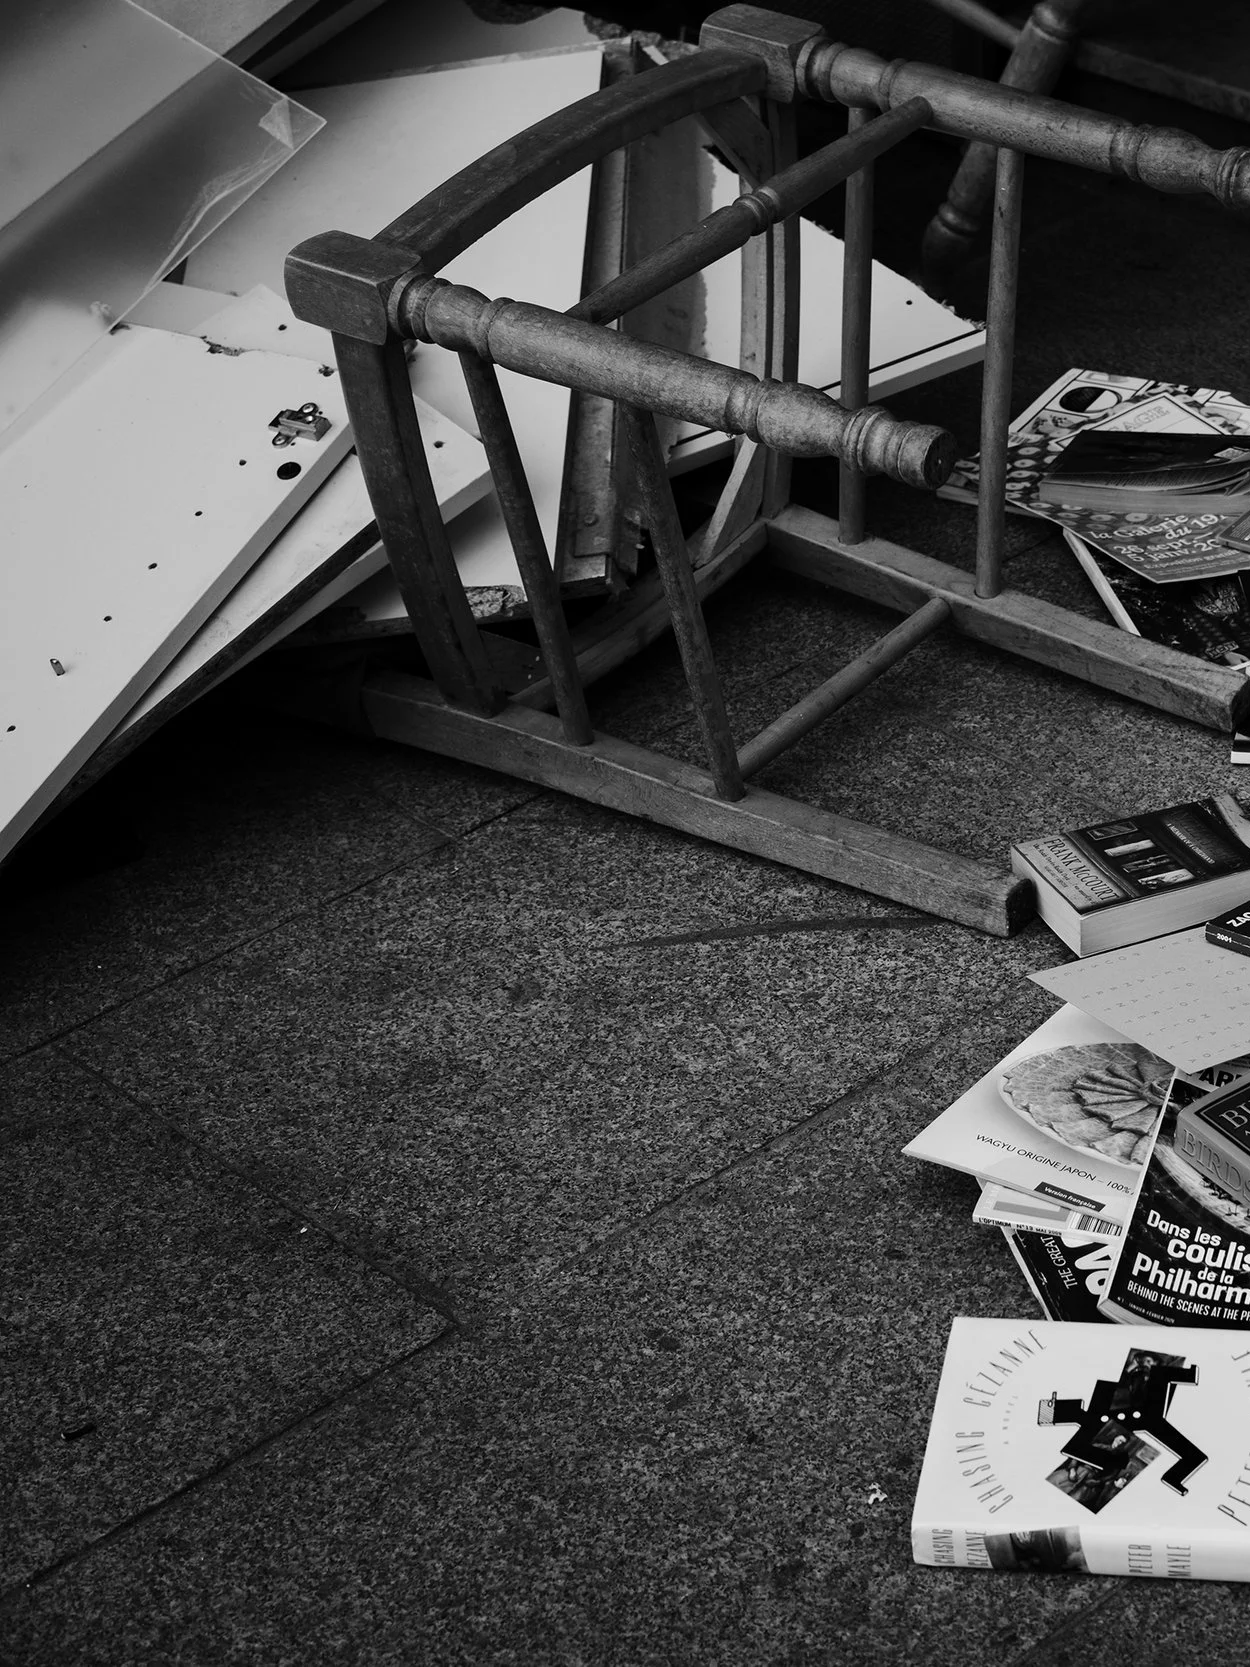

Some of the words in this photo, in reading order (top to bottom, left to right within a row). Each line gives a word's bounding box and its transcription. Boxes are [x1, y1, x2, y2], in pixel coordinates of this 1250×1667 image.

[1088, 525, 1112, 540] la
[1112, 513, 1190, 538] Galerie
[1164, 525, 1192, 540] du
[1113, 545, 1144, 555] 26
[1146, 537, 1199, 553] sept.
[1145, 549, 1197, 562] janv.
[1043, 837, 1081, 872] FRANK
[1072, 863, 1120, 901] McCOURT
[1216, 932, 1232, 943] 2001
[976, 1134, 1016, 1152] WAGYU
[1016, 1147, 1061, 1169] ORIGINE
[1060, 1163, 1097, 1182] JAPON
[1106, 1180, 1130, 1195] 100%
[1044, 1186, 1069, 1200] Version
[1067, 1194, 1097, 1210] française
[1147, 1209, 1190, 1239] Dans
[1194, 1226, 1221, 1247] les
[1041, 1236, 1067, 1266] GREAT
[1058, 1267, 1078, 1290] THE
[1197, 1266, 1217, 1282] de
[1220, 1270, 1234, 1285] la
[1127, 1280, 1158, 1303] BEHIND
[1159, 1291, 1176, 1308] THE
[1176, 1296, 1209, 1316] SCENES
[1210, 1305, 1222, 1318] AT
[1222, 1308, 1239, 1322] THE
[962, 1329, 1048, 1408] CÉZANNE
[955, 1431, 1014, 1514] CHASING
[931, 1528, 956, 1565] CHASING
[1127, 1543, 1153, 1575] PETER
[1166, 1543, 1191, 1577] MAYLE
